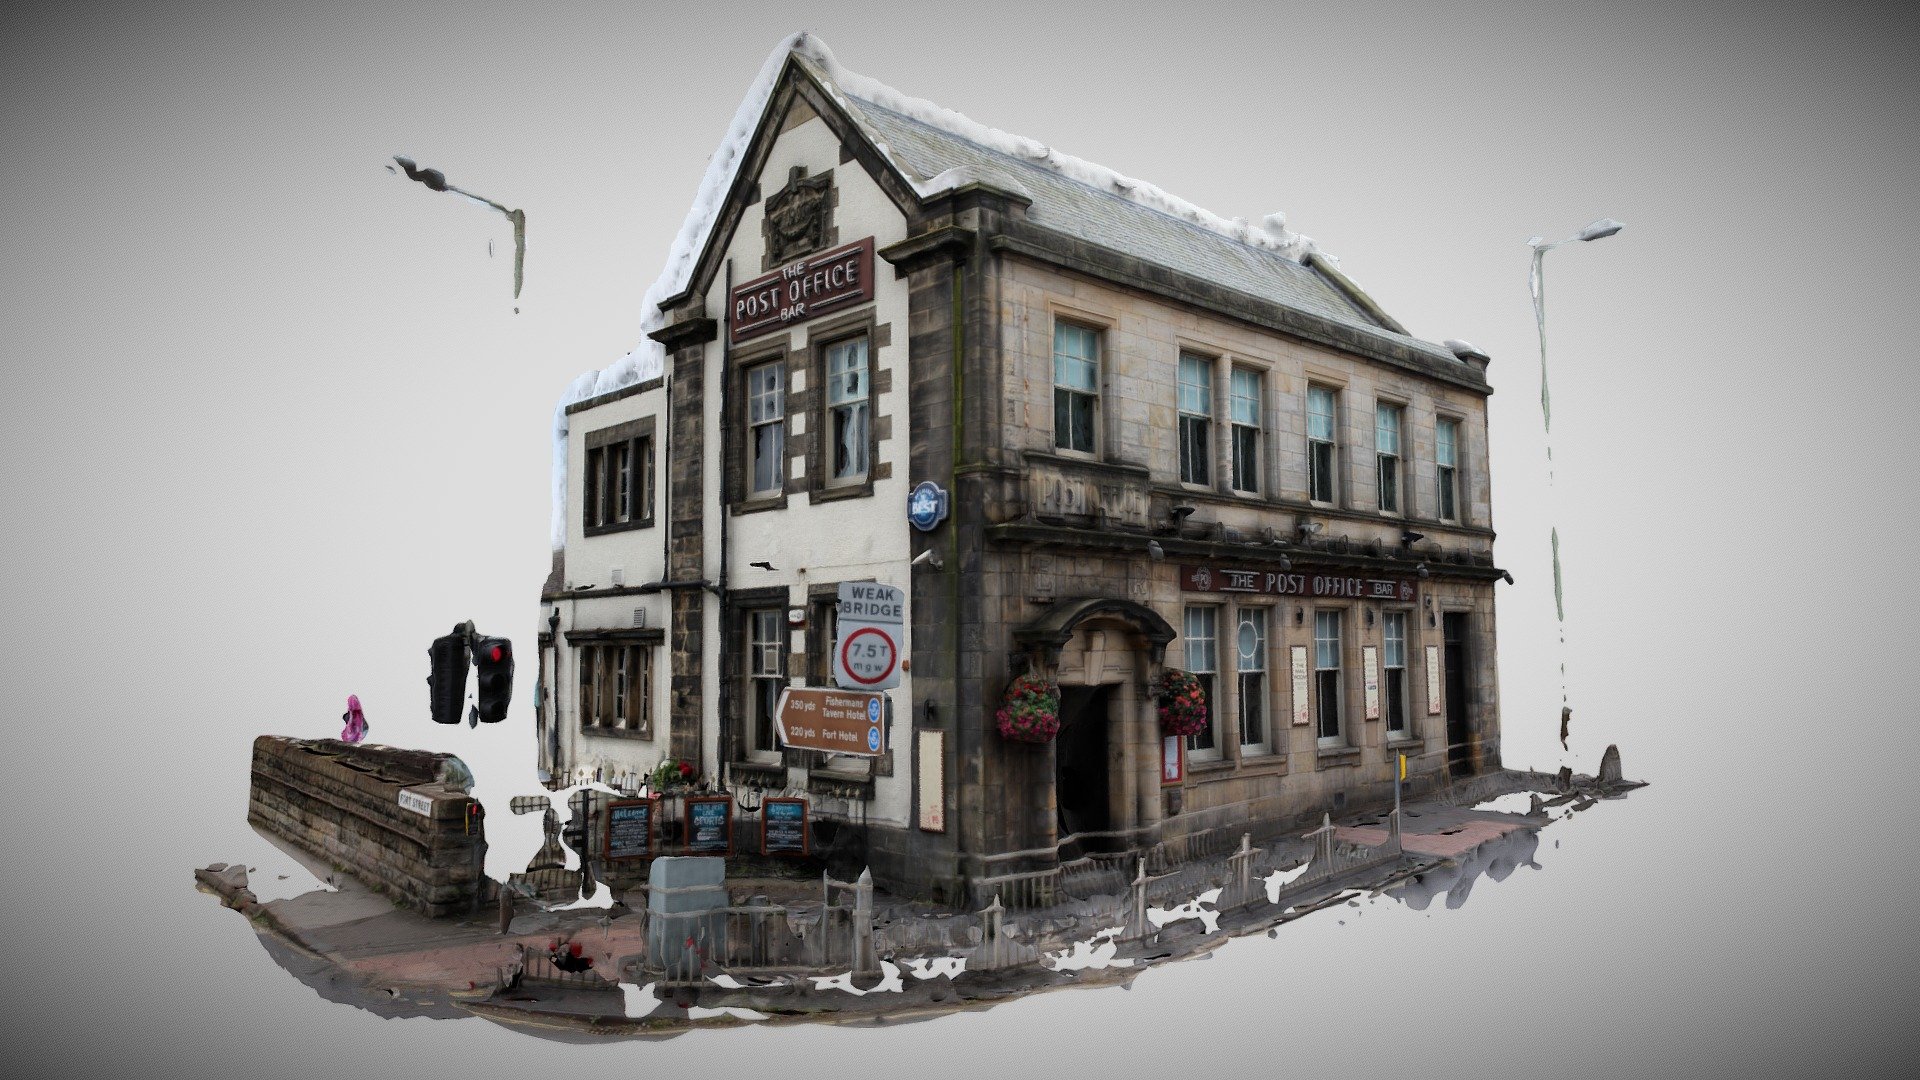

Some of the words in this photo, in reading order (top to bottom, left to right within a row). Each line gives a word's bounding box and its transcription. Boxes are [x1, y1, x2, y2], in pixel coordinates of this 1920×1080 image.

[781, 261, 805, 280] THE
[736, 288, 780, 320] POST
[789, 260, 857, 303] OFFICE
[780, 303, 805, 322] BAR
[1231, 574, 1254, 588] THE
[1265, 572, 1305, 594] POST
[1313, 576, 1362, 597] OFFICE
[1374, 583, 1393, 595] BAR
[852, 586, 894, 601] WEAK
[843, 603, 902, 617] BRIDGE
[790, 700, 803, 710] 350
[804, 702, 816, 712] yds
[825, 695, 864, 708] Fishermans
[822, 708, 844, 718] Tavern
[846, 710, 866, 721] Hotel
[790, 726, 803, 737] 220
[803, 728, 816, 739] yds
[822, 729, 837, 740] Fort
[838, 731, 858, 742] Hotel
[399, 793, 411, 806] FORT
[412, 798, 430, 813] STREET
